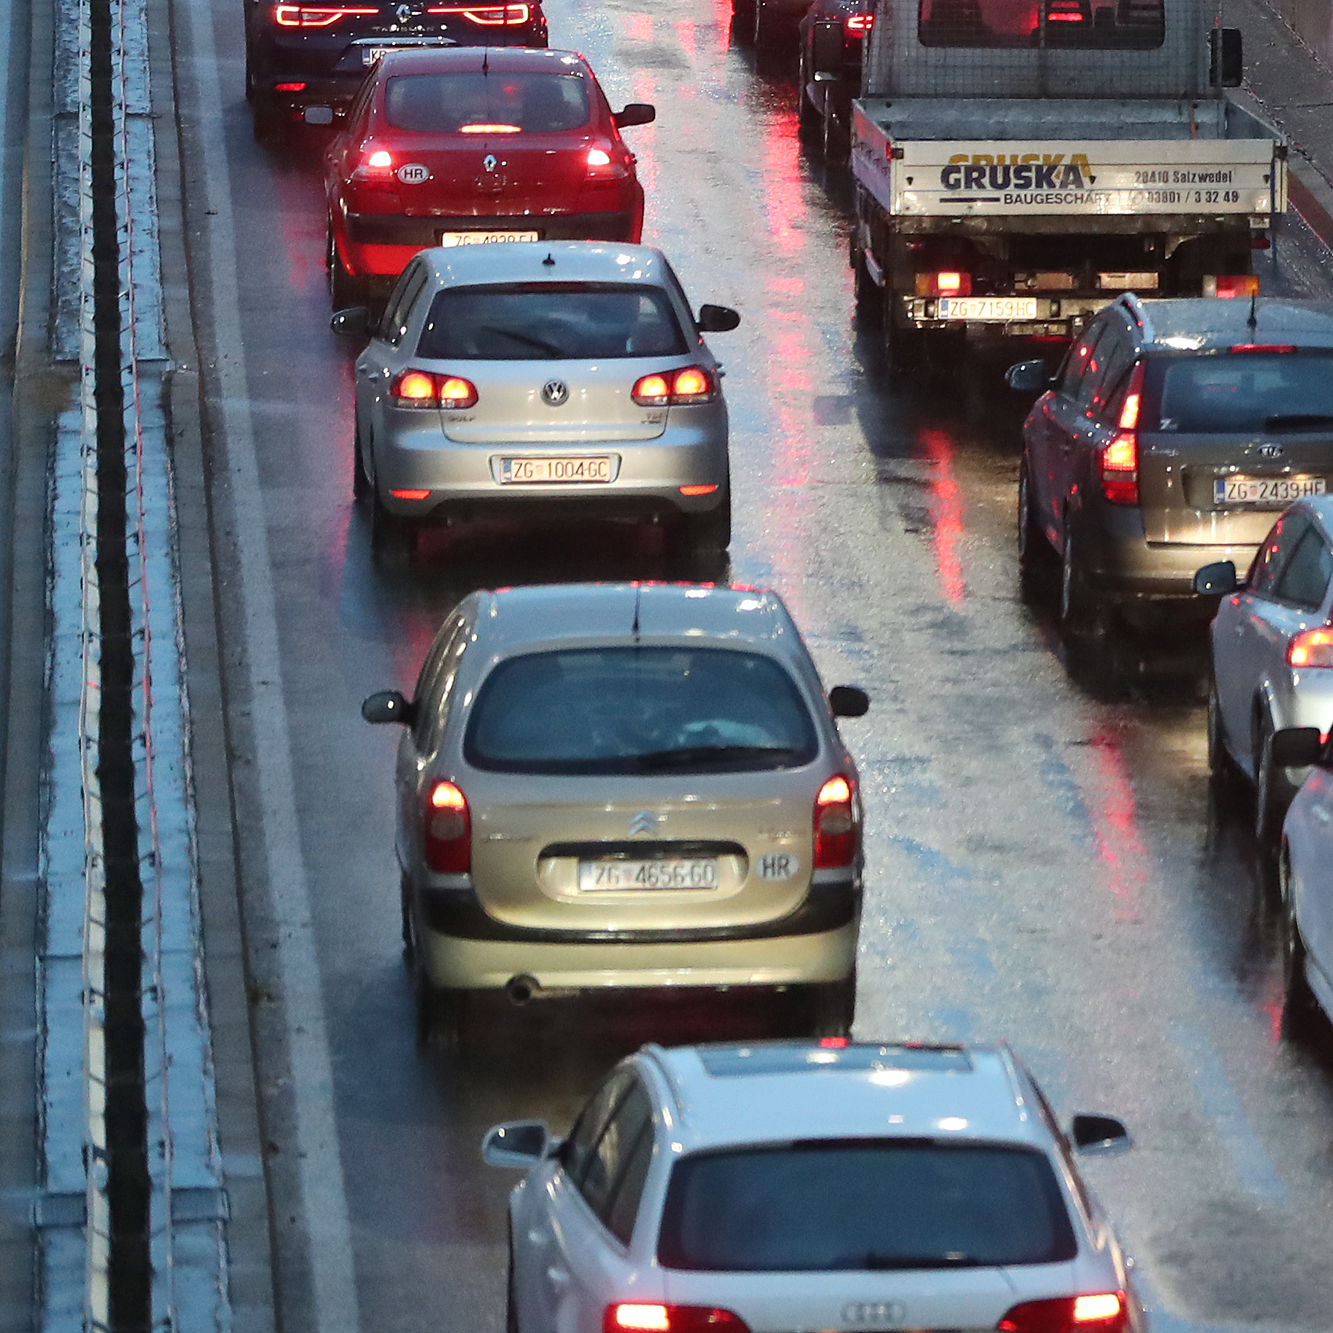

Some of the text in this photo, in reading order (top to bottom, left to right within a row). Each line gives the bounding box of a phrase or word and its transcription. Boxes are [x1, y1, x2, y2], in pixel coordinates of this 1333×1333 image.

[403, 168, 424, 179] HR
[940, 164, 1085, 191] GRUSKA
[1172, 170, 1232, 184] Salzwedel
[1194, 191, 1202, 204] 3
[1205, 191, 1219, 204] 32
[514, 461, 534, 479] ZG
[1228, 483, 1248, 501] ZG
[761, 857, 790, 879] HR
